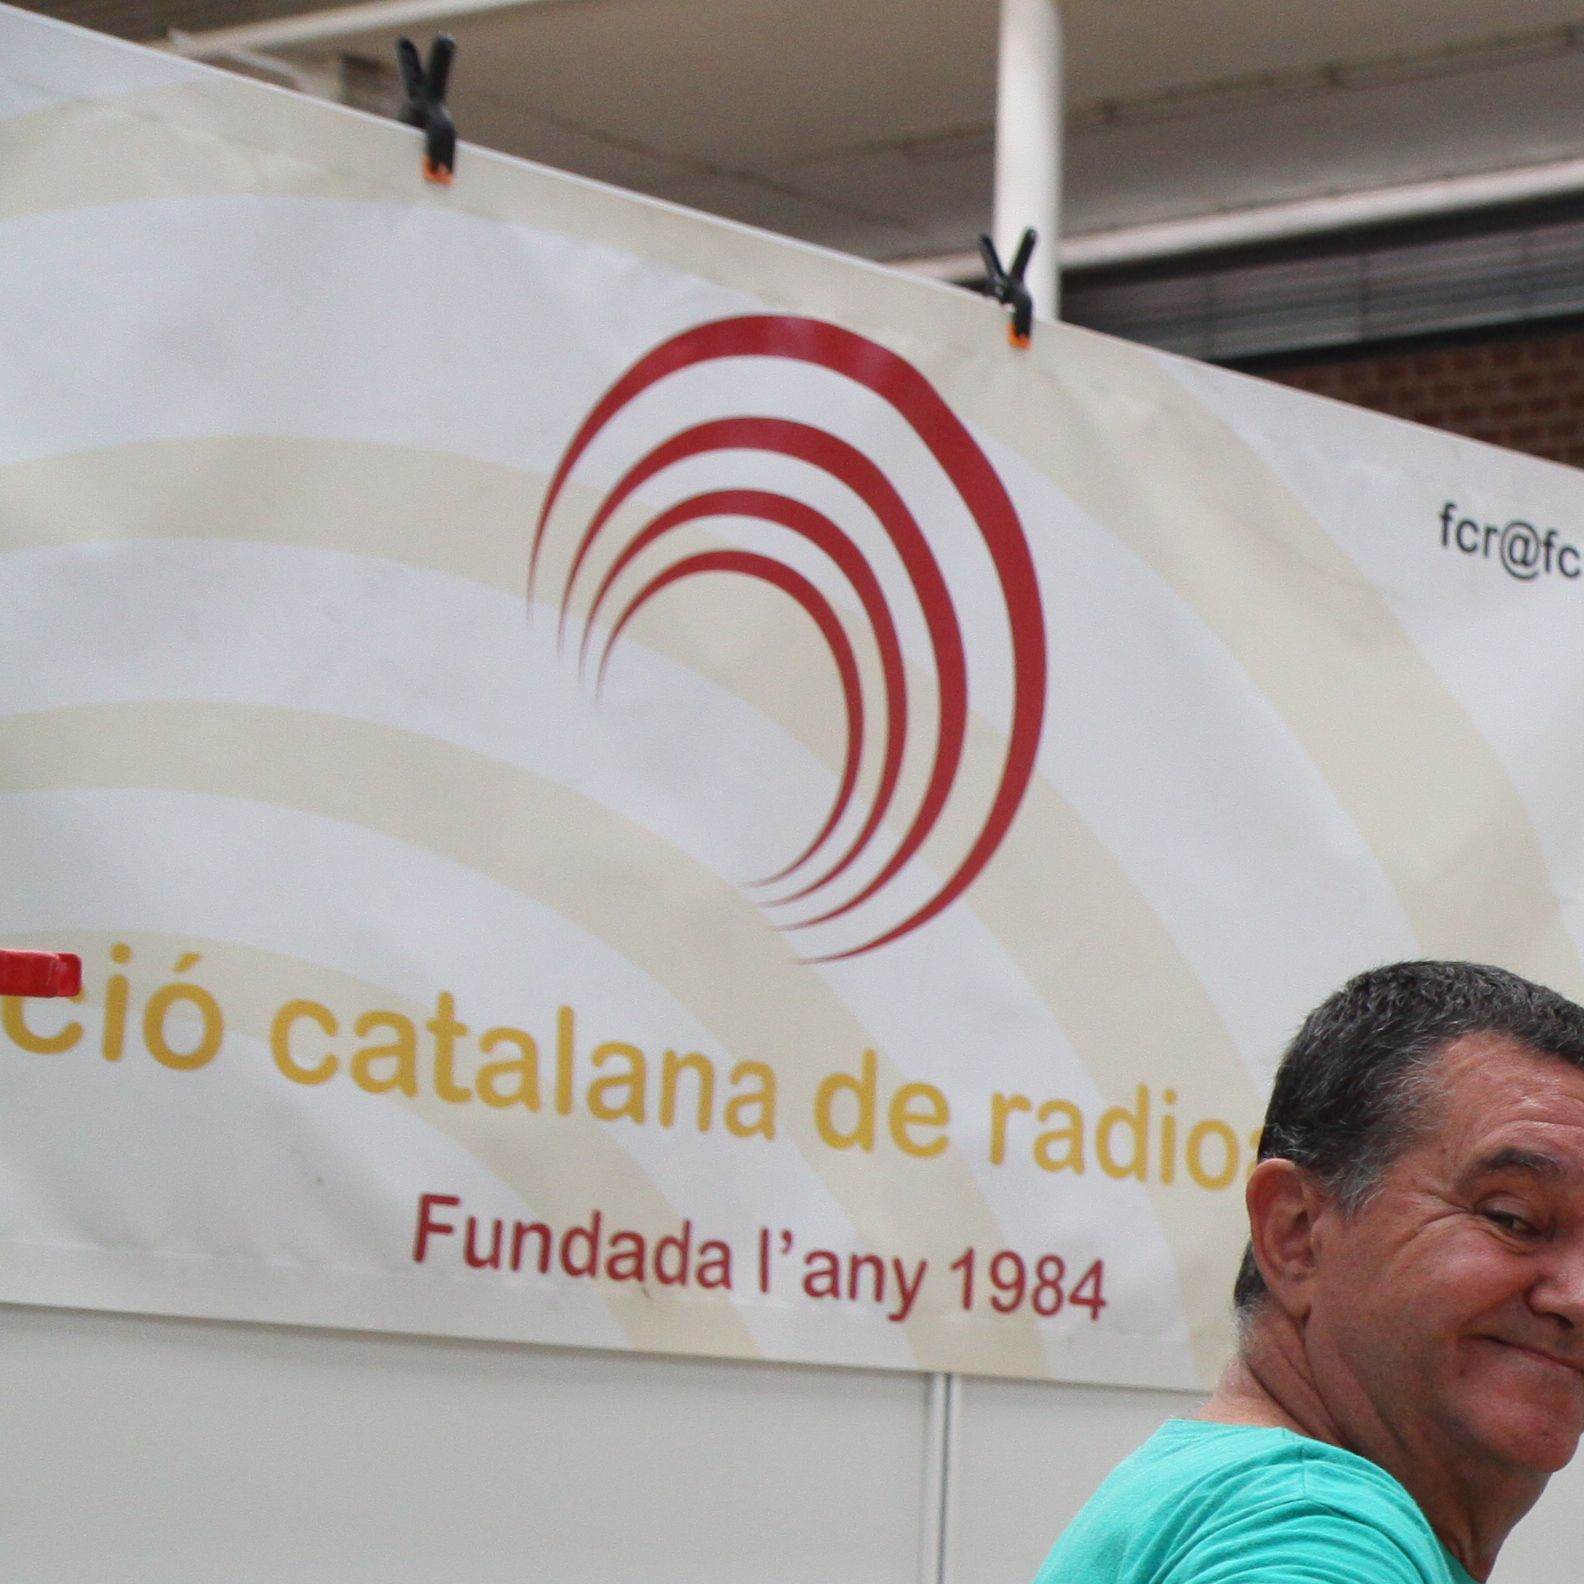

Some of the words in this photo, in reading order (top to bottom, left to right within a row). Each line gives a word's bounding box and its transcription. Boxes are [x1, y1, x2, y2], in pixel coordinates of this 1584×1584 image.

[270, 991, 777, 1141] catalana
[813, 1047, 951, 1159] de
[988, 1082, 1258, 1192] radio
[412, 1193, 733, 1291] Fundada
[759, 1226, 928, 1323] l’any
[950, 1246, 1108, 1321] 1984
